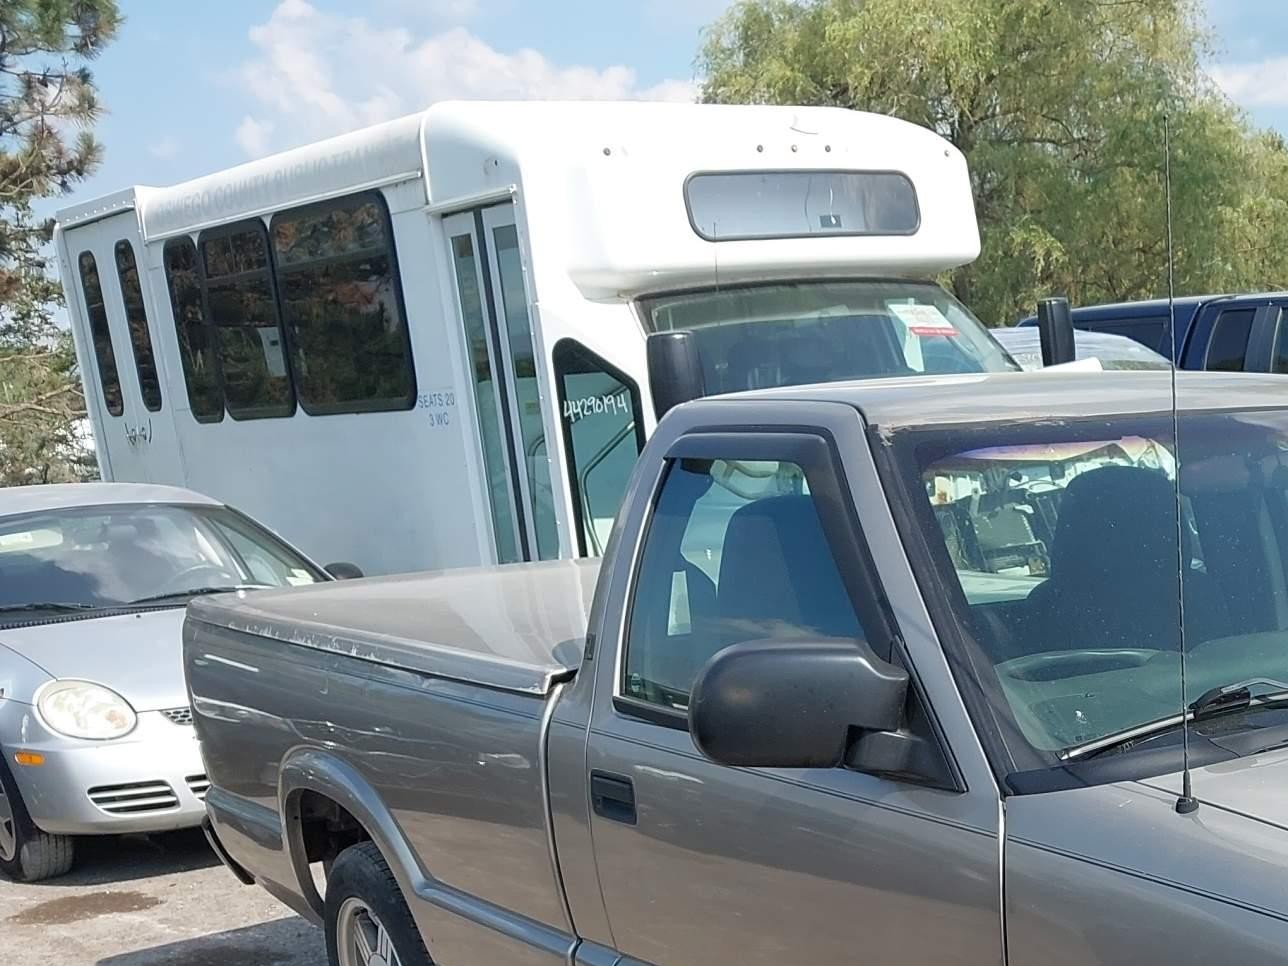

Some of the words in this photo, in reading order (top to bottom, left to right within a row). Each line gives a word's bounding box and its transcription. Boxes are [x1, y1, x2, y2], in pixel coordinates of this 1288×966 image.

[418, 393, 443, 408] SEATS
[445, 392, 455, 406] 20
[563, 393, 628, 422] 44290194
[429, 413, 435, 427] 3
